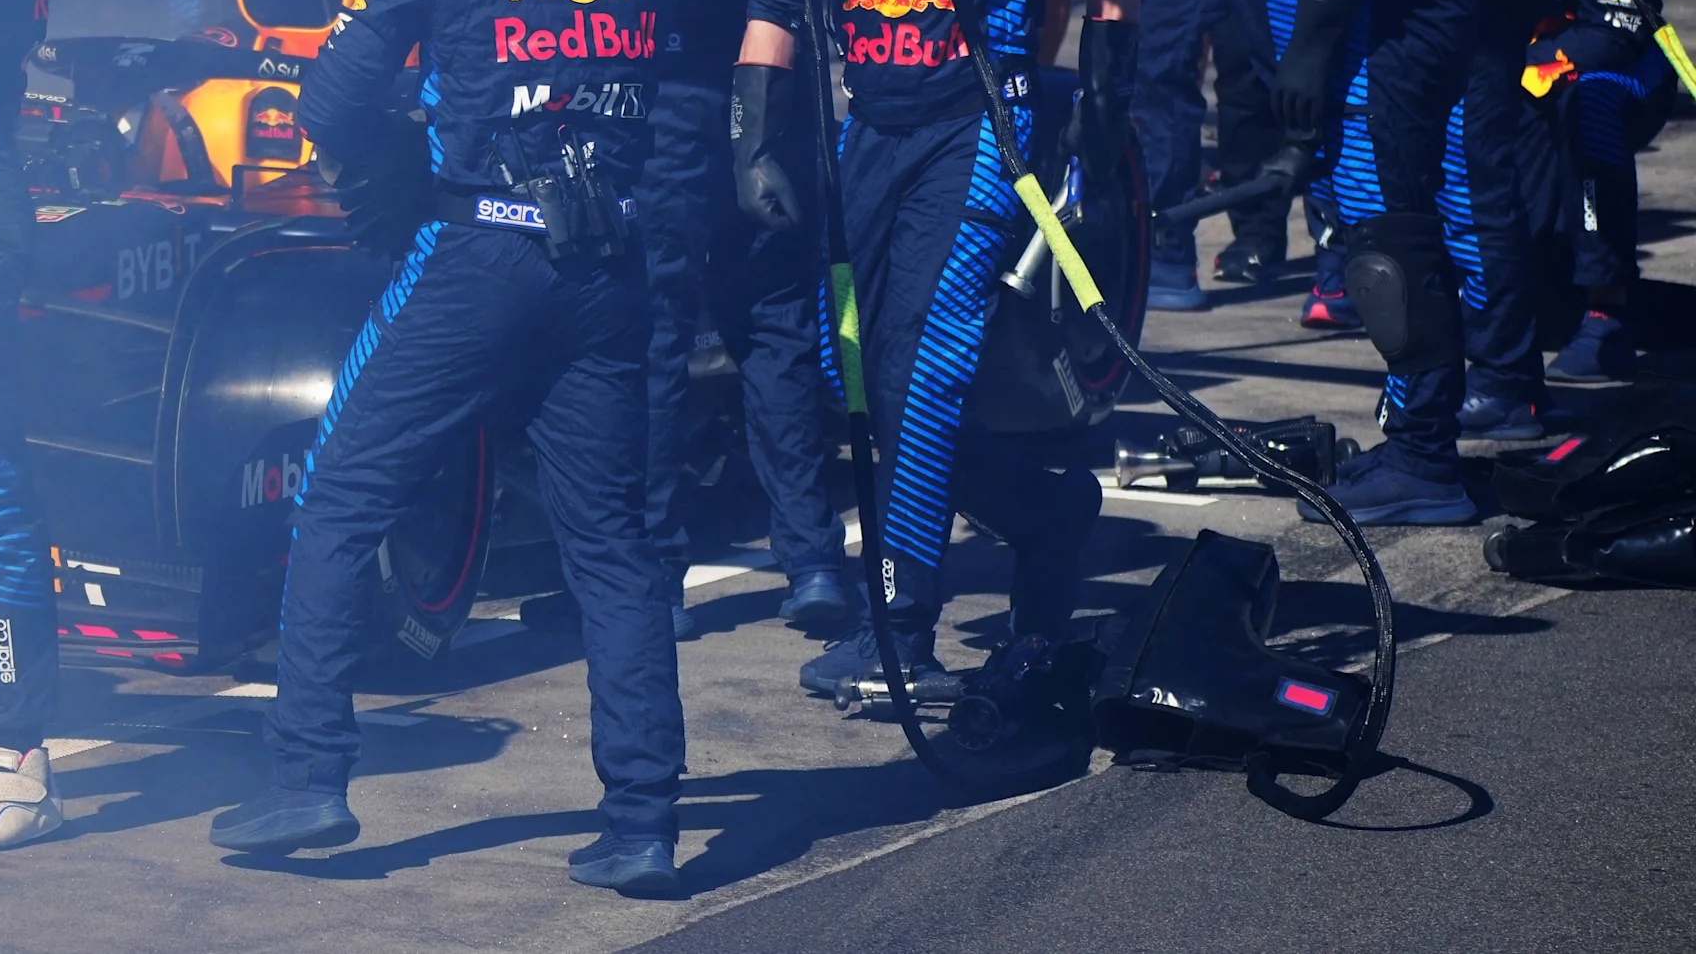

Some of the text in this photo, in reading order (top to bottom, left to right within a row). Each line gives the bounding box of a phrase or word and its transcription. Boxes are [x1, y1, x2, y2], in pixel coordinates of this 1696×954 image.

[493, 9, 590, 64] Red
[477, 197, 547, 230] sparc
[117, 230, 202, 300] BYBIT
[240, 452, 303, 509] Mob
